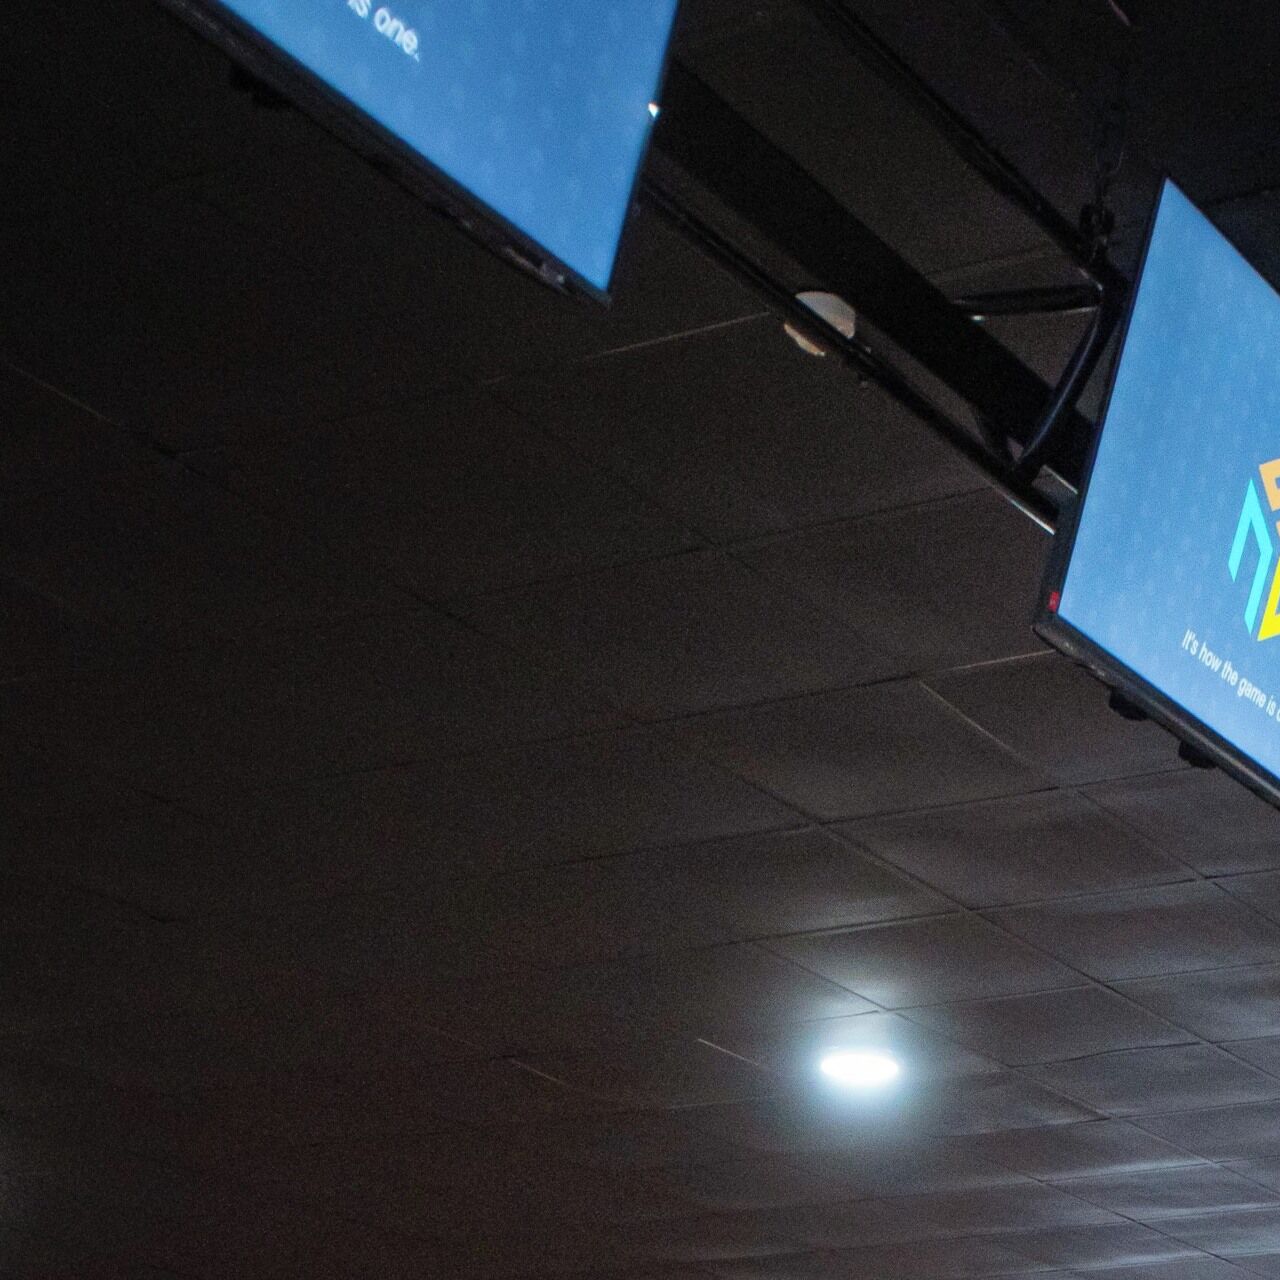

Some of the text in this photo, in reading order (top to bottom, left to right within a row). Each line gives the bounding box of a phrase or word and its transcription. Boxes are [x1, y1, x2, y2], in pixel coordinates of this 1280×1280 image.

[374, 8, 420, 62] one.
[1182, 629, 1199, 655] It's
[1199, 641, 1222, 672] how
[1221, 660, 1238, 686] the
[1237, 677, 1267, 708] game
[1266, 695, 1277, 716] is
